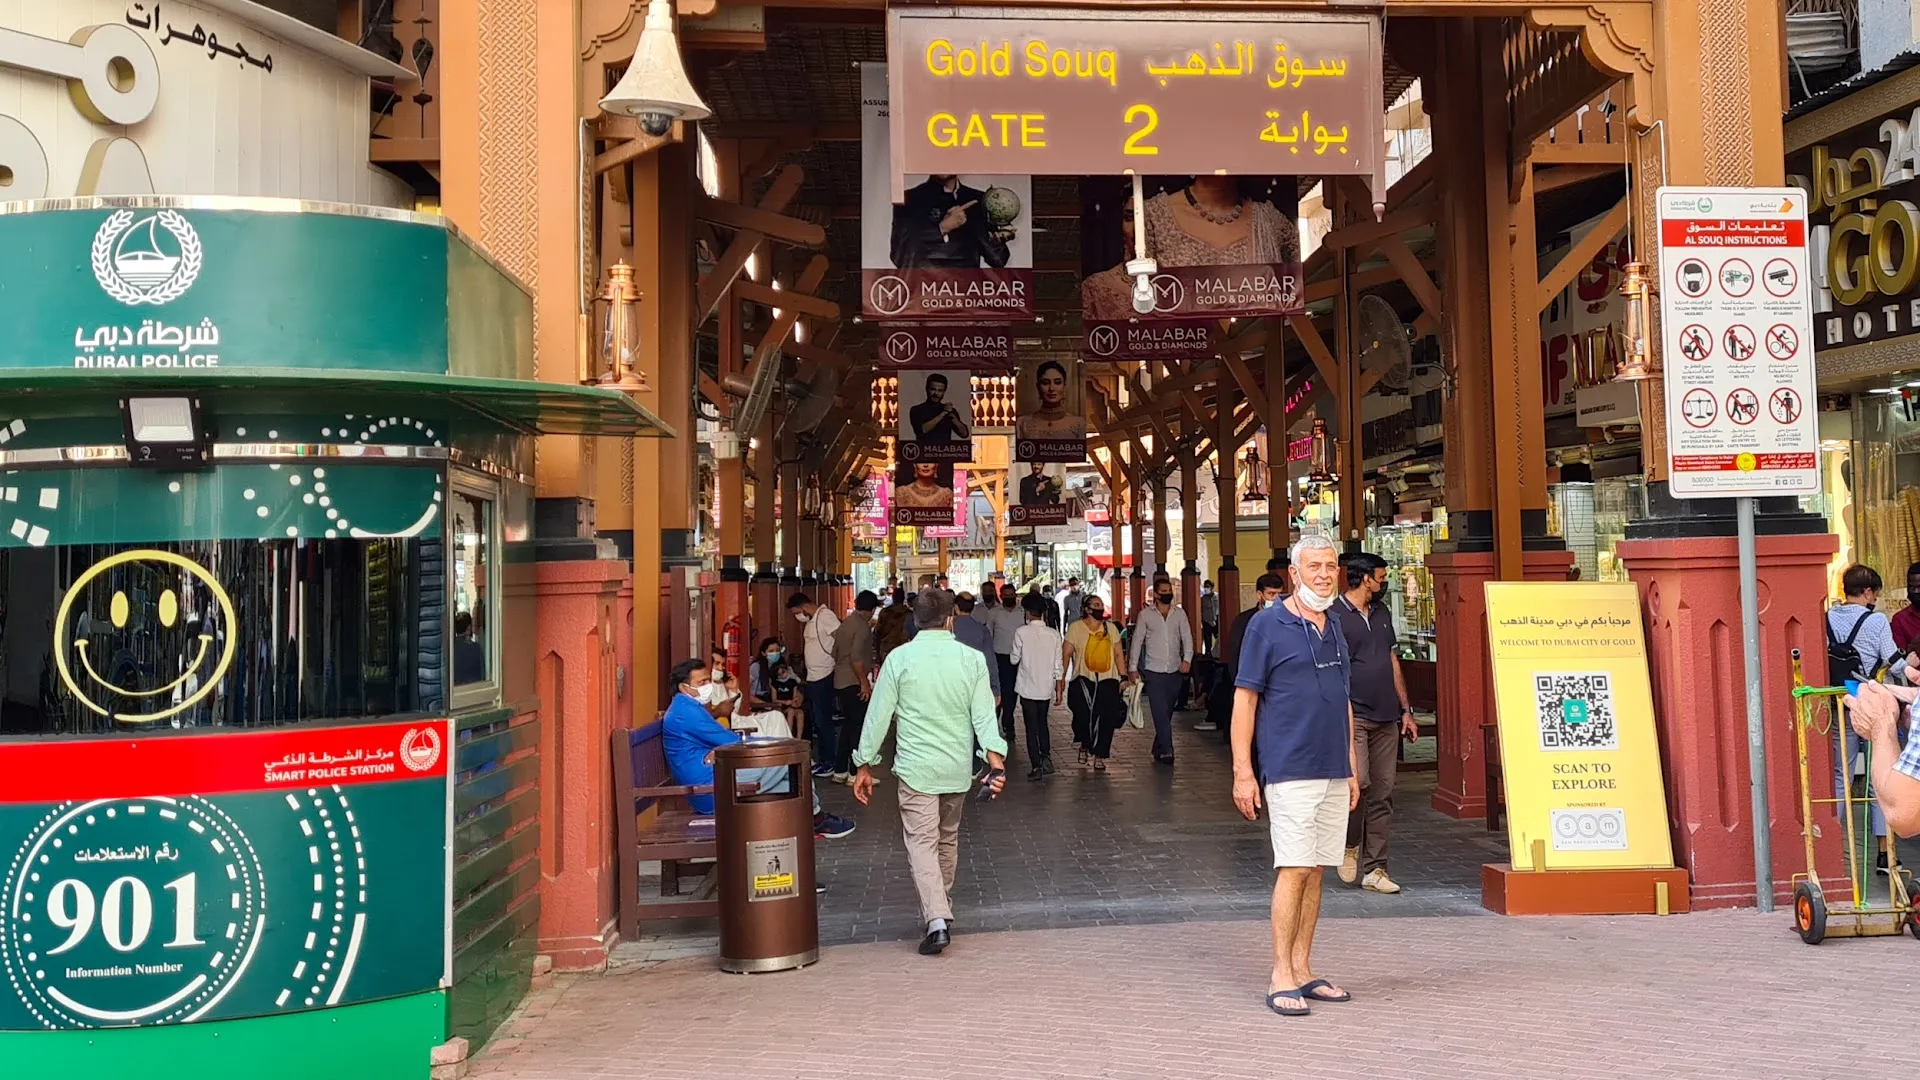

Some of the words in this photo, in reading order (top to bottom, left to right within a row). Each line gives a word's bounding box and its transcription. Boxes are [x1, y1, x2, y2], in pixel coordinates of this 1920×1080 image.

[126, 2, 273, 74] مجوهرات
[926, 38, 1011, 78] Gold
[1024, 40, 1117, 86] Souq
[1146, 40, 1254, 87] الذهب
[1266, 42, 1347, 88] سوق
[926, 113, 1047, 148] GATE
[1123, 104, 1160, 155] 2
[1259, 110, 1349, 155] بوابة
[1686, 220, 1726, 234] السوق
[1728, 221, 1785, 234] تعليمات
[1685, 236, 1696, 244] AL
[1698, 235, 1723, 246] SOUQ
[1725, 235, 1787, 245] INSTRUCTIONS
[921, 281, 1025, 297] MALABAR
[1195, 276, 1295, 293] MALABAR
[922, 299, 953, 308] GOLD
[955, 299, 963, 308] &
[964, 298, 1025, 308] DIAMONDS
[1196, 296, 1227, 305] GOLD
[1239, 293, 1296, 303] DIAMONDS
[74, 325, 133, 352] دبي
[136, 316, 219, 352] شرطة
[1128, 328, 1207, 341] MALABAR
[926, 336, 1007, 349] MALABAR
[1129, 342, 1152, 351] GOLD
[1161, 341, 1207, 350] DIAMONDS
[926, 350, 951, 358] GOLD
[960, 350, 1008, 358] DIAMONDS
[141, 354, 218, 368] POLICE
[924, 445, 969, 453] MALABAR
[1040, 443, 1083, 451] MALABAR
[914, 510, 951, 518] MALABAR
[1499, 615, 1528, 628] الذهب
[1530, 615, 1554, 627] مدينة
[1556, 616, 1572, 629] دبي
[1575, 616, 1589, 629] في
[1591, 616, 1607, 628] بكم
[1613, 638, 1636, 646] GOLD
[307, 749, 362, 764] الشرطة
[363, 748, 394, 761] مركز
[264, 752, 305, 771] الذكي
[264, 769, 307, 783] SMART
[308, 767, 346, 779] POLICE
[349, 763, 394, 775] STATION
[1553, 763, 1588, 774] SCAN
[1591, 763, 1612, 773] TO
[1552, 778, 1617, 790] EXPLORE
[74, 845, 150, 862] الاستعلامات
[155, 842, 179, 863] رقم
[46, 871, 206, 955] 901
[65, 965, 132, 978] Information
[135, 962, 183, 975] Number
